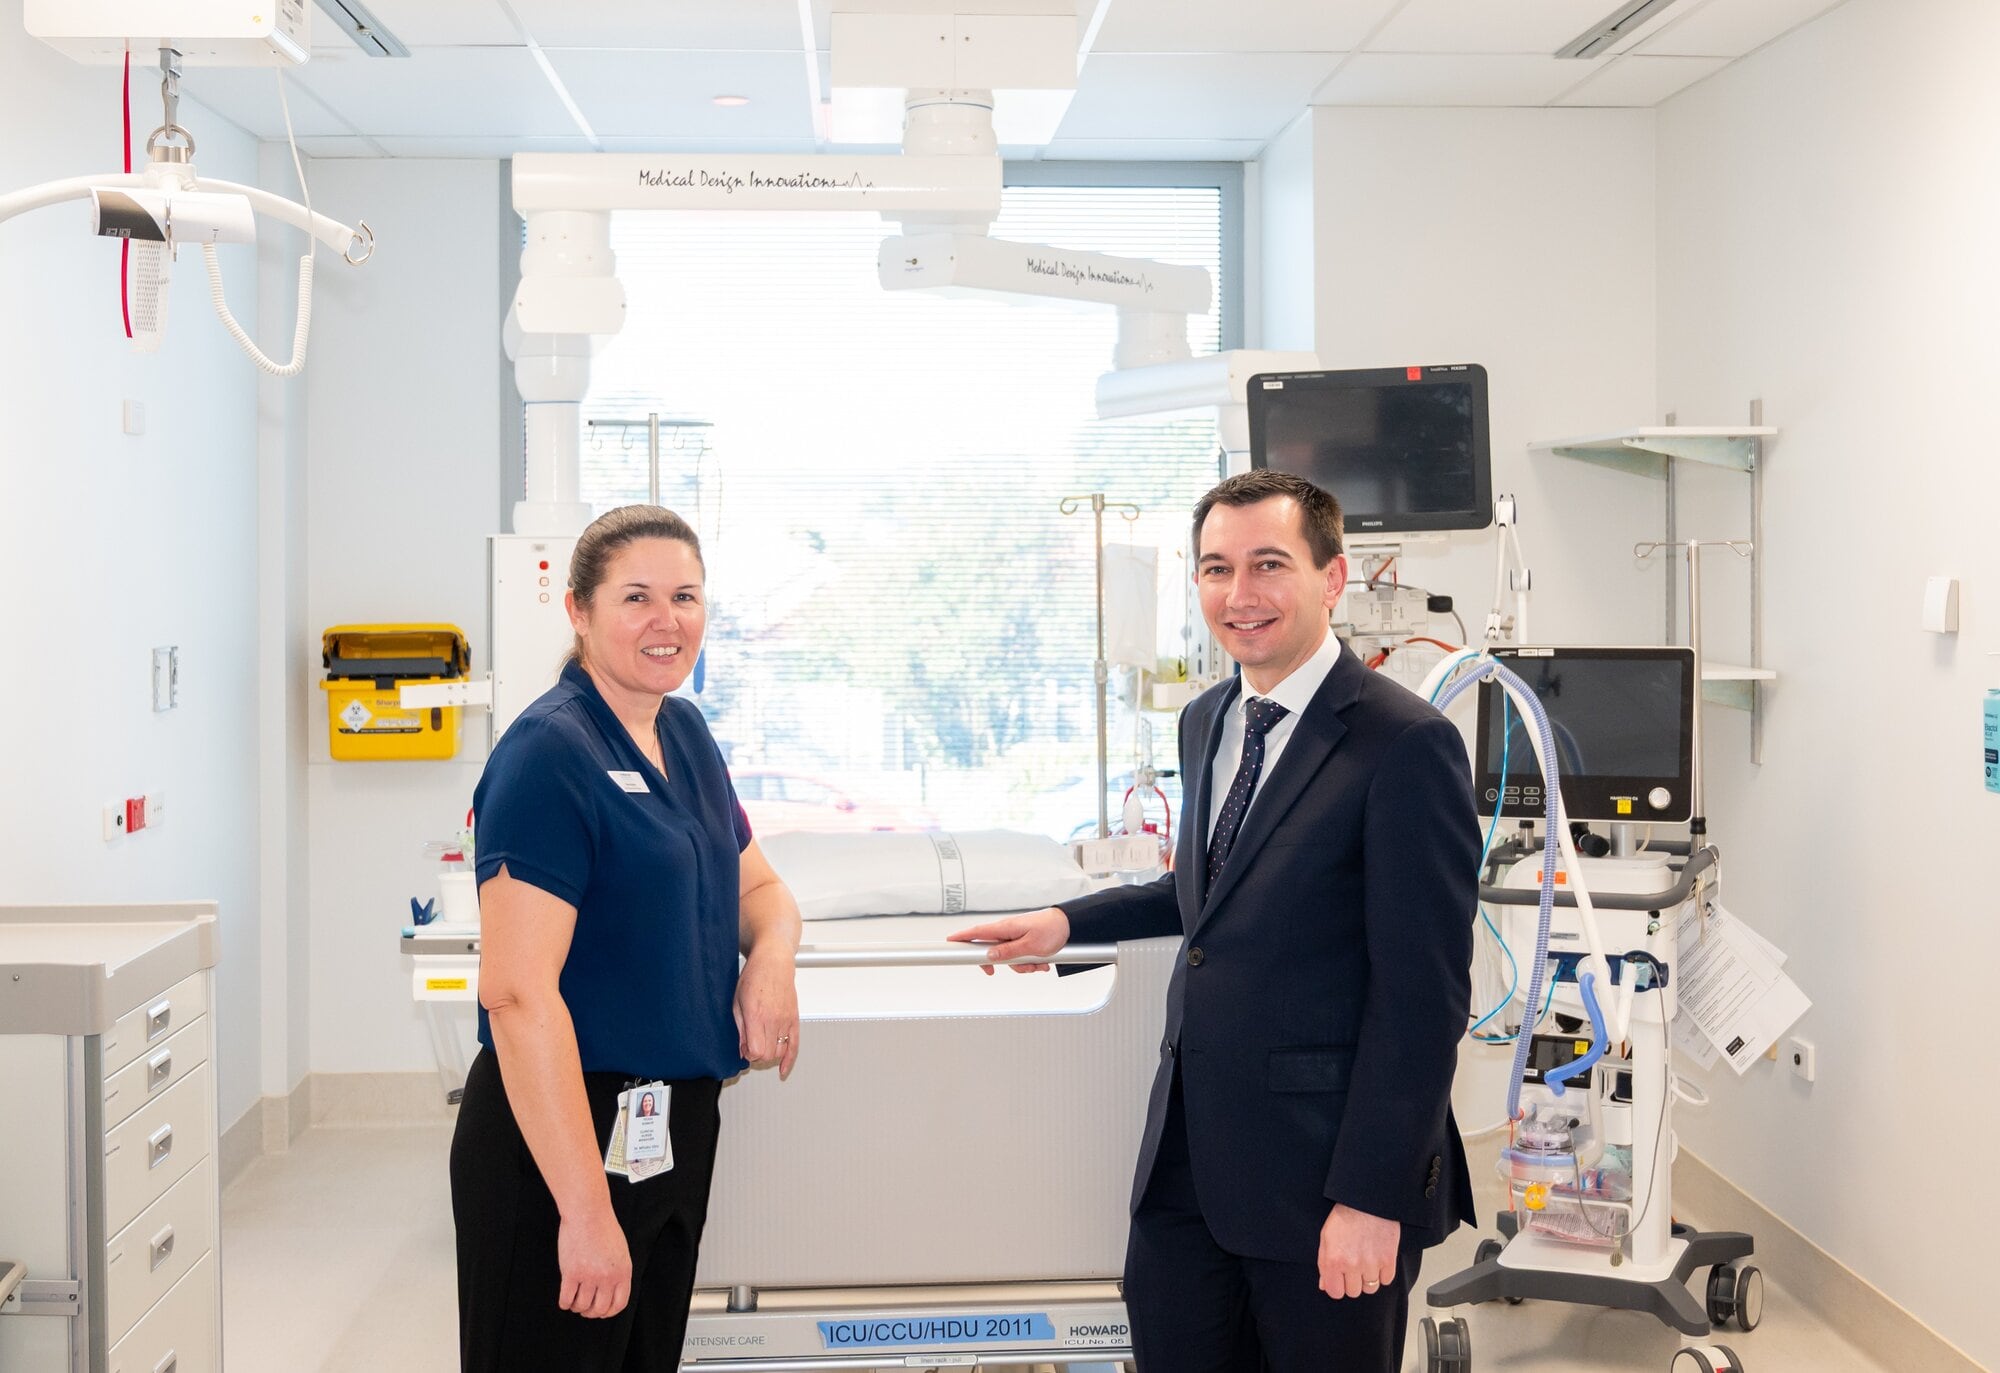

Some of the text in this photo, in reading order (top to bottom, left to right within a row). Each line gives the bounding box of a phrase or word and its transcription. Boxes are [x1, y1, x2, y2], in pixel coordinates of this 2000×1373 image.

[639, 169, 837, 194] Medical Design Innovations
[1027, 257, 1134, 286] Medical Design Innovations
[685, 1336, 766, 1347] INTENSIVE CARE
[829, 1318, 1032, 1343] ICU/CCU/HDU 2011
[1069, 1325, 1129, 1337] HOWARD
